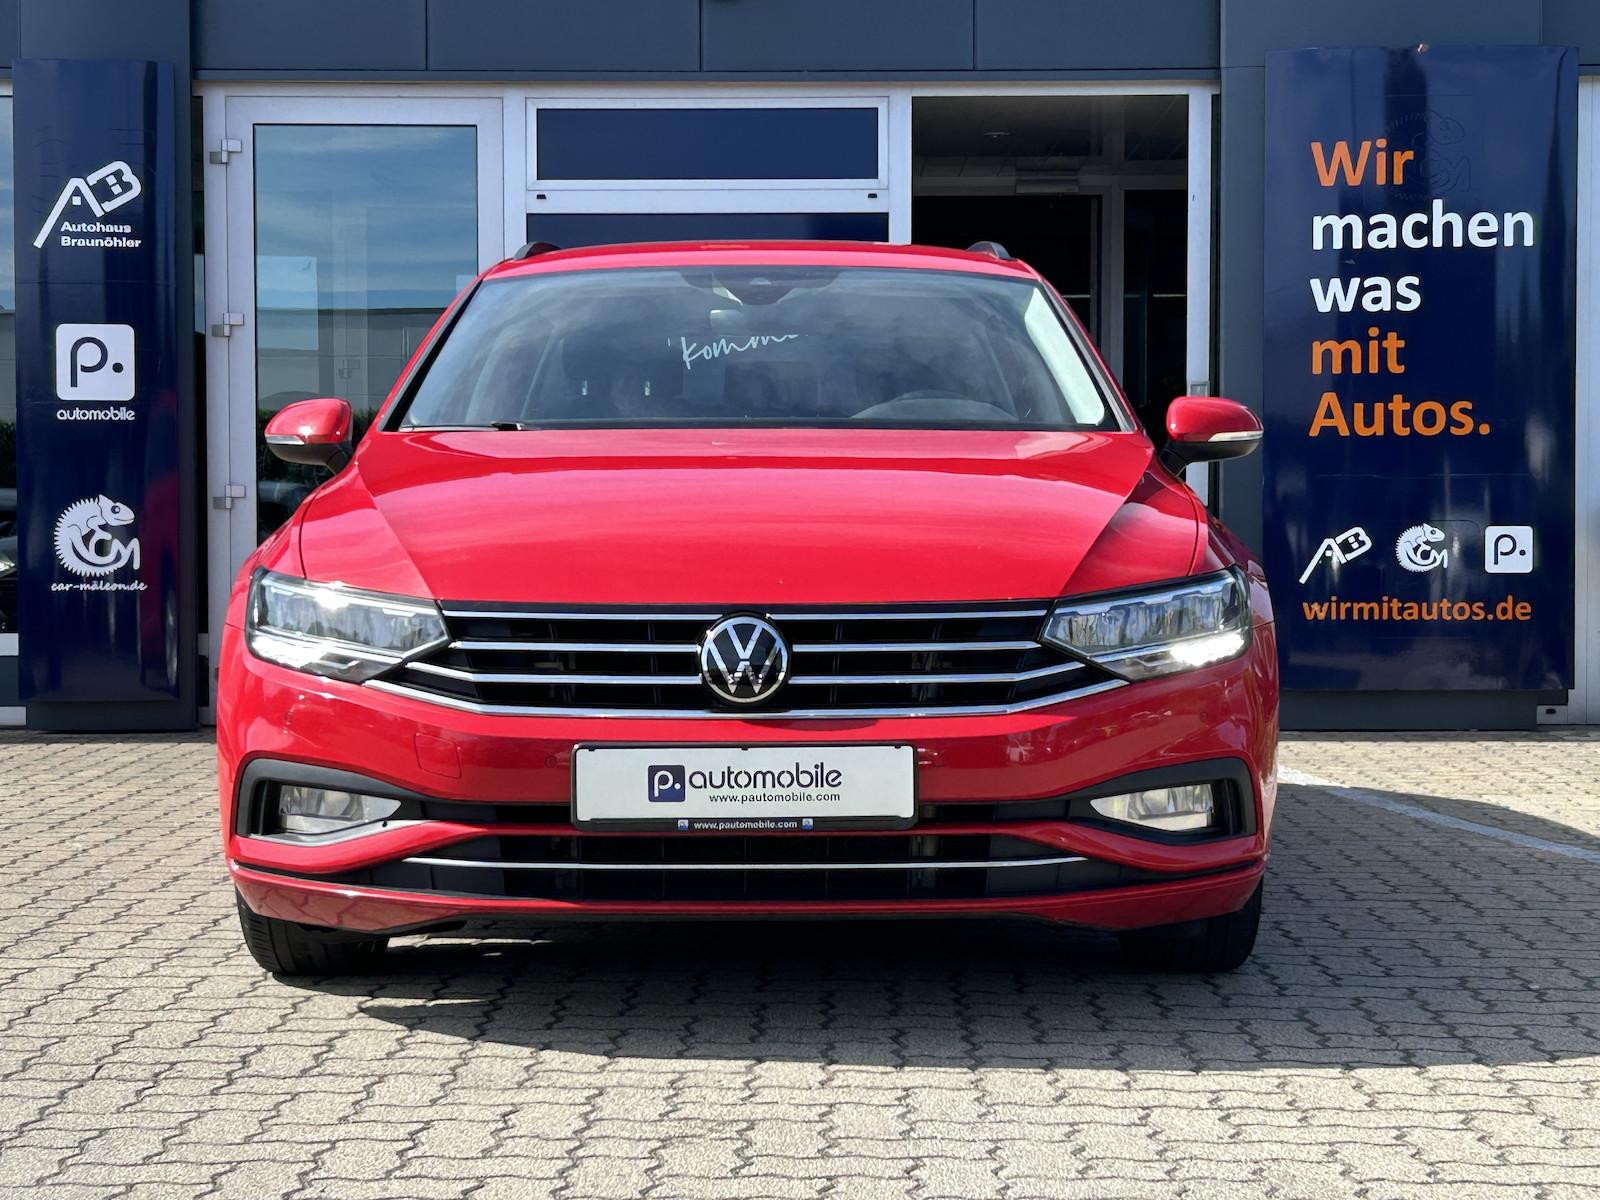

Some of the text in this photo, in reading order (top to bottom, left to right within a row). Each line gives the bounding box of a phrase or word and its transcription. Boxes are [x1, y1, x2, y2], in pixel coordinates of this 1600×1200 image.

[1310, 138, 1415, 187] Wir
[60, 221, 132, 234] Autohaus
[1311, 198, 1535, 251] machen
[60, 235, 142, 248] Braunöhler
[1309, 274, 1422, 313] was
[1311, 326, 1406, 375] mit
[56, 406, 136, 421] automobile
[1308, 391, 1491, 437] Autos.
[1302, 594, 1533, 621] wirmitautos.de
[702, 617, 788, 702] VW
[688, 761, 842, 790] automobile
[708, 791, 841, 805] www.pautomobile.com
[693, 818, 798, 831] www.pautomobile.com
